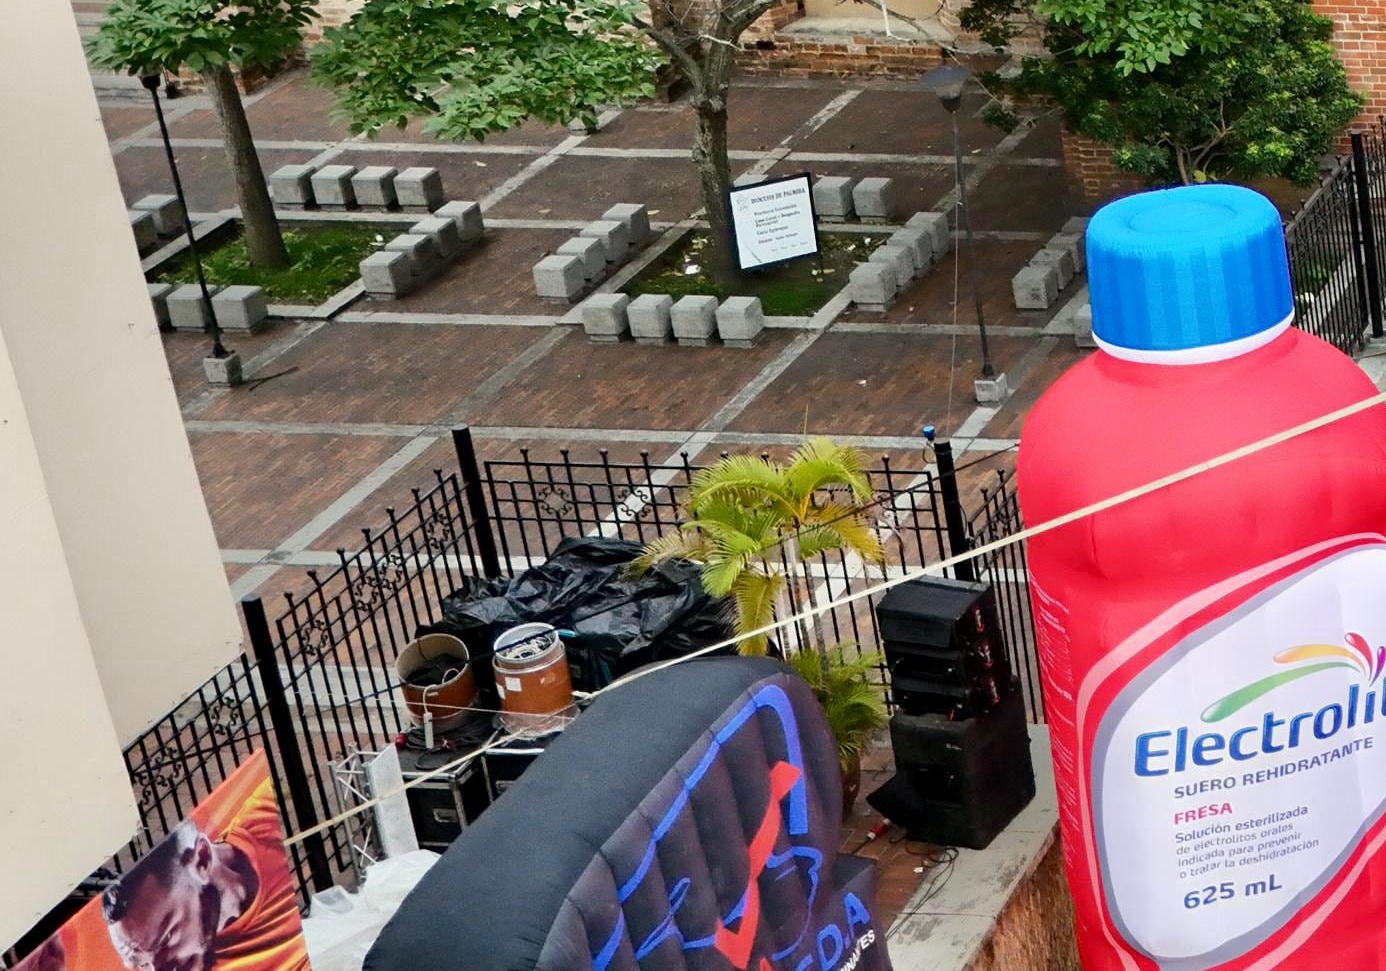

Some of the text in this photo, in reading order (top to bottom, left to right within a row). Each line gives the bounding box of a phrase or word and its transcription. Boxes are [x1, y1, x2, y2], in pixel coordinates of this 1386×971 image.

[1174, 736, 1374, 799] SUERO REHIDRATANTE
[1174, 802, 1233, 825] FRESA
[1175, 805, 1308, 843] Solución esterilizada
[1176, 823, 1293, 856] de electrolitos orales
[1178, 832, 1302, 868] indicada para prevenir
[1179, 839, 1319, 879] o tratar la deshidratación
[1183, 873, 1282, 909] 625 mL
